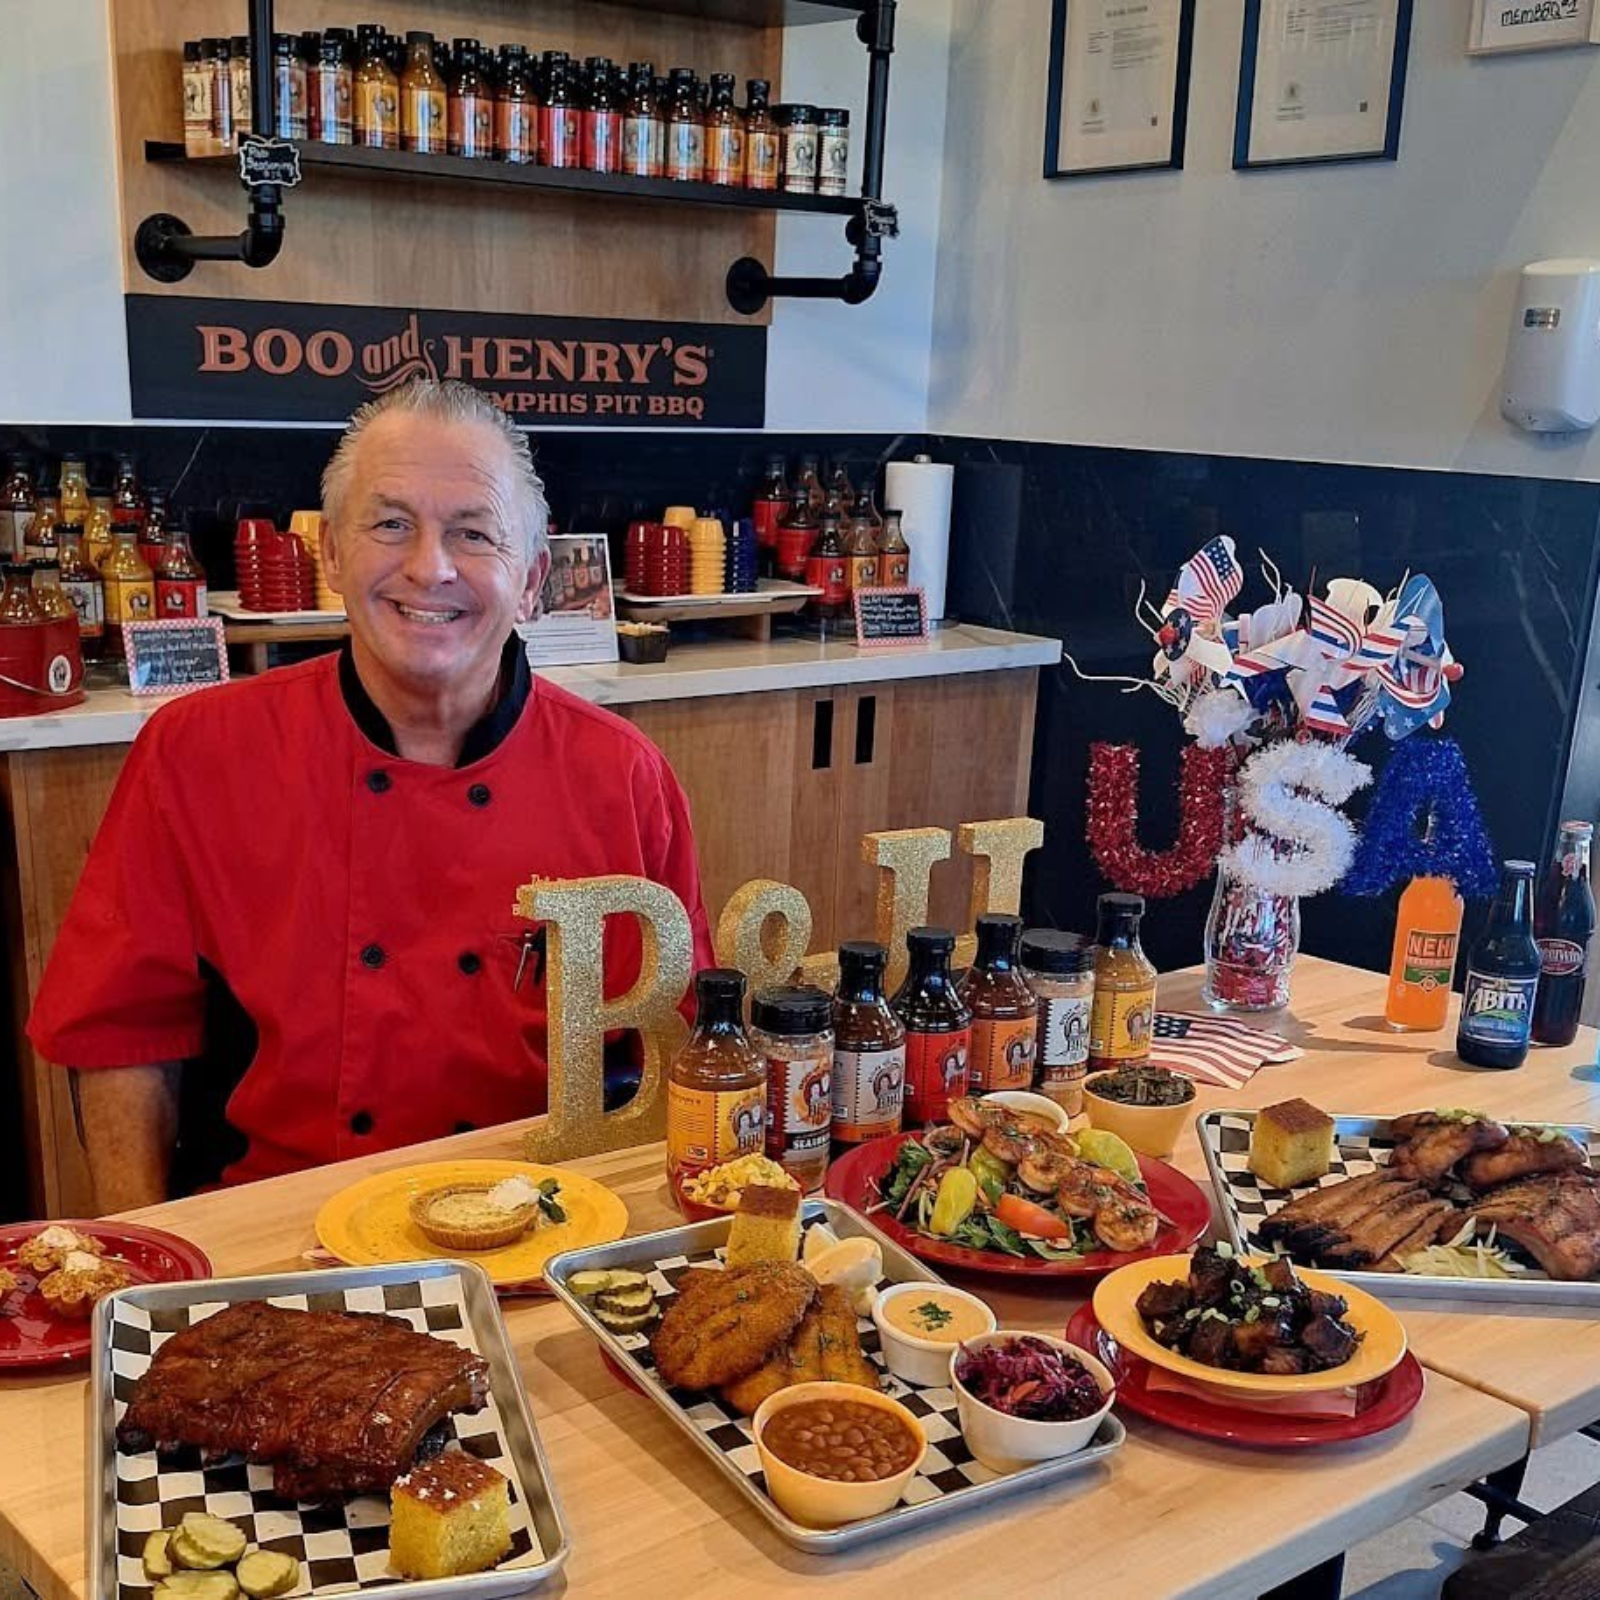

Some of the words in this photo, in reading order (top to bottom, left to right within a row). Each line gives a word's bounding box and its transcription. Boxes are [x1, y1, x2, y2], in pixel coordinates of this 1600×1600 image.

[196, 325, 354, 377] BOO
[357, 313, 430, 384] and
[443, 335, 709, 386] HENRY'S
[489, 391, 587, 414] MPHIS
[595, 394, 641, 414] PIT
[648, 396, 705, 419] BBQ
[514, 874, 694, 1163] B
[1468, 988, 1528, 1013] ABITA
